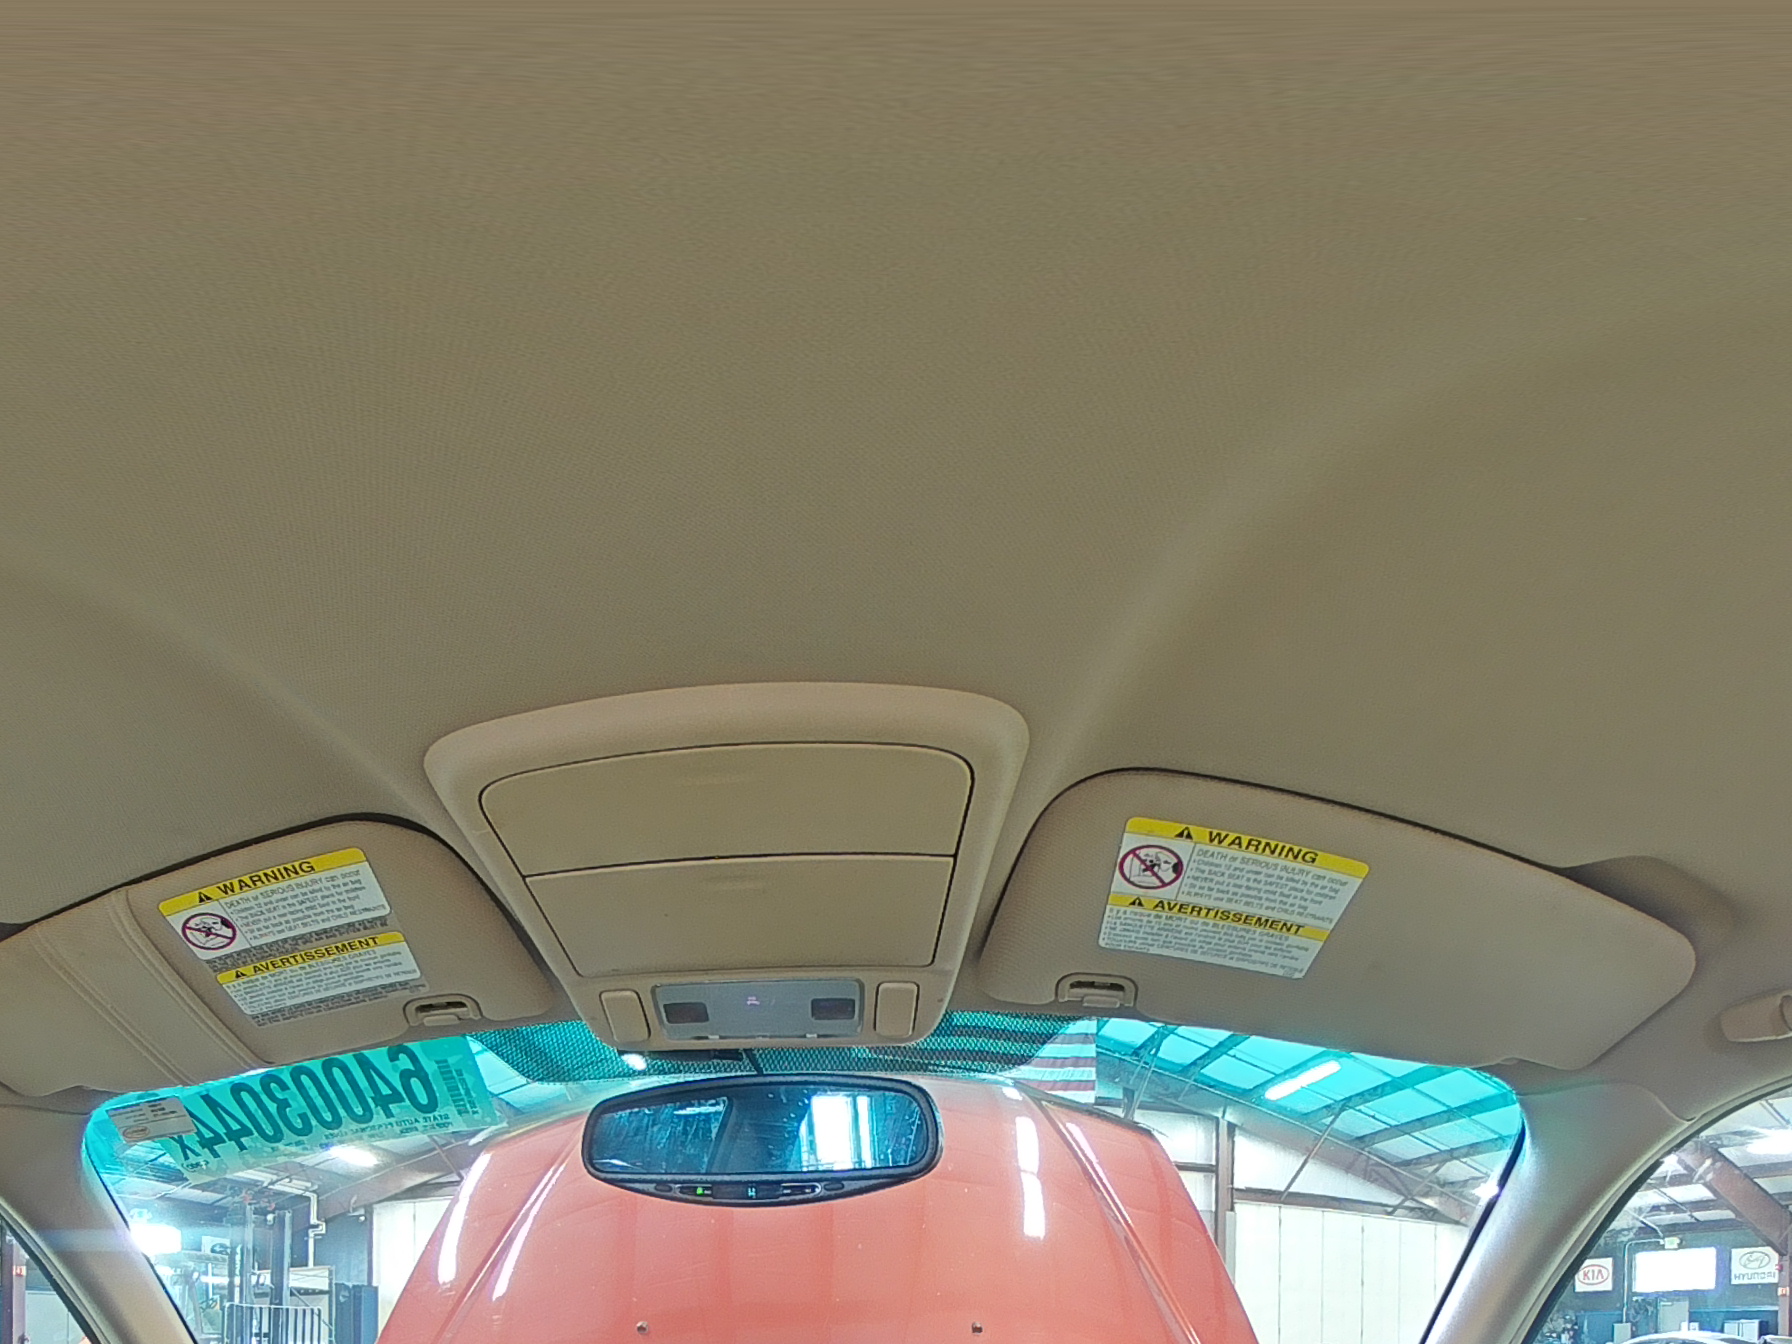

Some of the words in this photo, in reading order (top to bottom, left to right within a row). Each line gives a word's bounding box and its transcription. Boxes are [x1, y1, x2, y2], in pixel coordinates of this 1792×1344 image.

[1208, 830, 1318, 864] WARNING
[217, 861, 315, 895] WARNING
[1153, 900, 1304, 935] AVERTISSEMENT
[252, 937, 379, 973] AVERTISSEMENT
[1582, 1269, 1604, 1281] KIA
[1734, 1272, 1776, 1282] HYUNDAI
